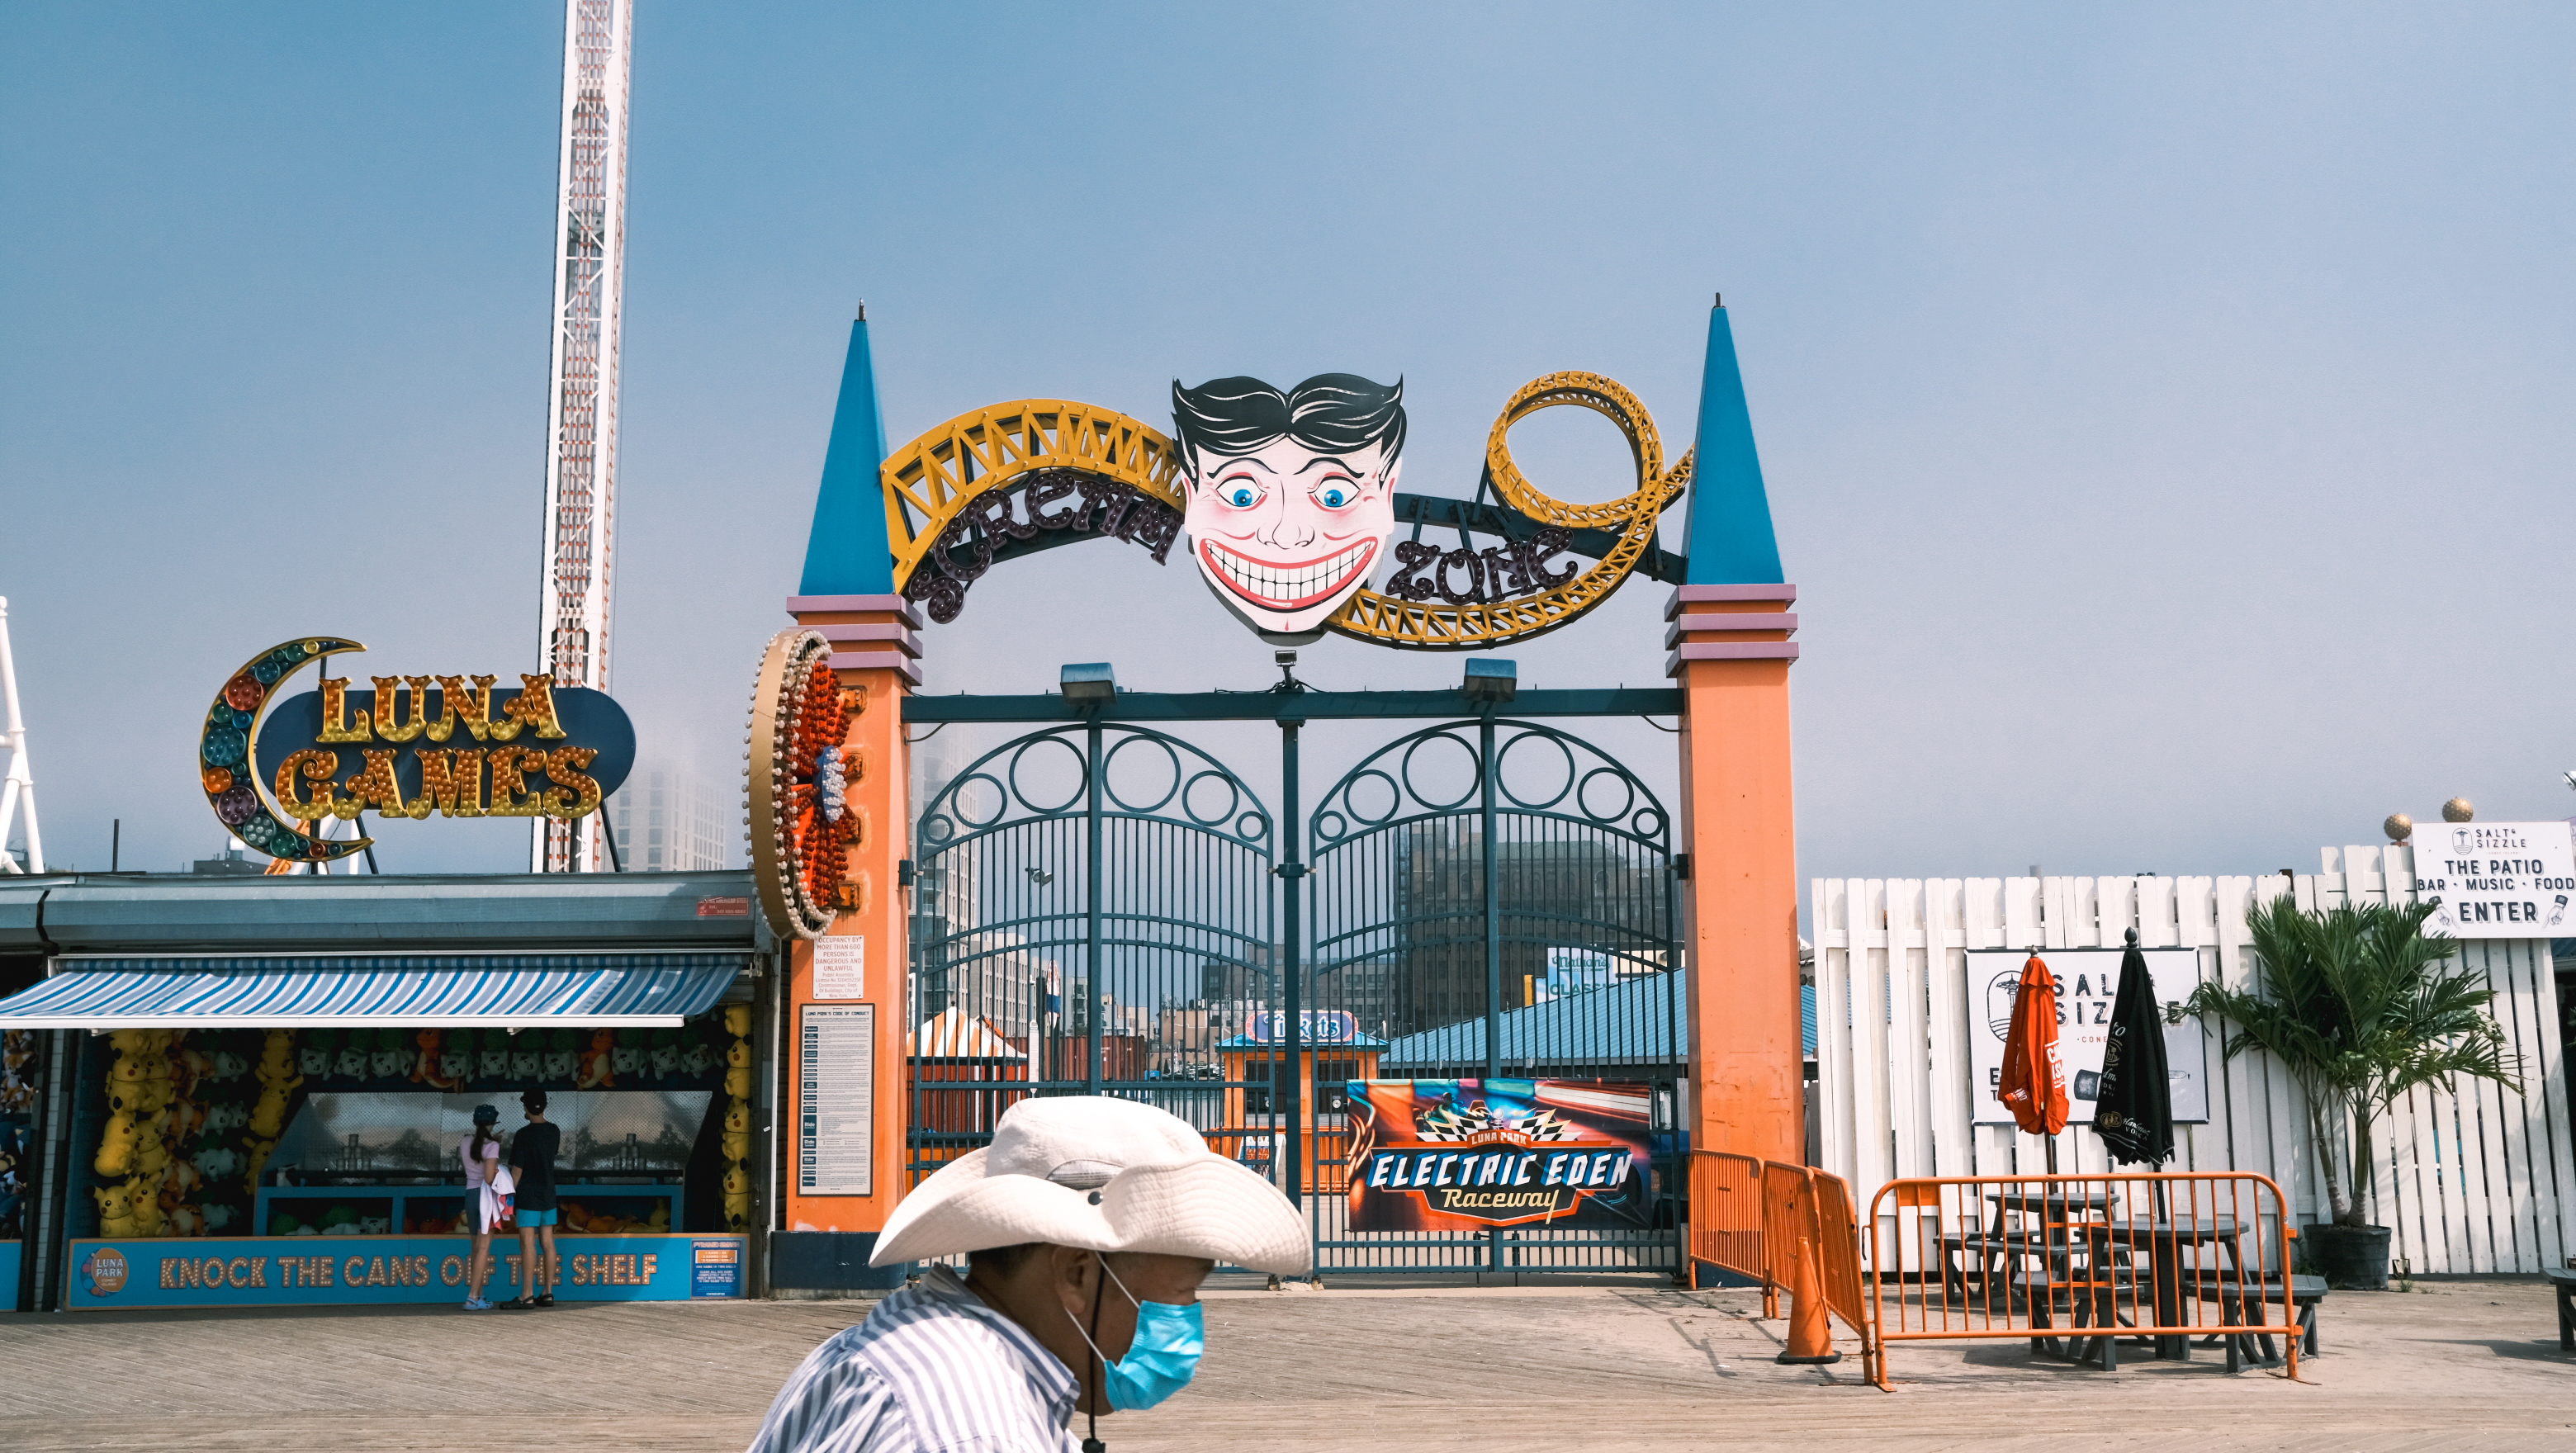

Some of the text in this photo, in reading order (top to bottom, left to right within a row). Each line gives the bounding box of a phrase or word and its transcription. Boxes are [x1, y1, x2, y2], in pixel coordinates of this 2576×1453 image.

[1385, 528, 1579, 605] ZONE
[316, 674, 566, 743] LUNA
[275, 745, 602, 820] GAMES
[2475, 828, 2509, 838] SALT
[2477, 839, 2526, 848] SIZZLE
[2445, 859, 2544, 875] THE PATIO
[2417, 878, 2575, 891] BAR MUSIC FOOD
[2459, 902, 2538, 923] ENTER
[1550, 983, 1616, 995] CLAS
[2053, 974, 2114, 997] SAL
[2055, 1001, 2181, 1025] SIZE
[1262, 1014, 1339, 1039] ikts
[1470, 1131, 1527, 1145] LUNA PARK
[2125, 1126, 2147, 1141] VOKA
[1366, 1151, 1537, 1187] ELECTRIC
[1541, 1150, 1633, 1186] EDEN
[1440, 1189, 1560, 1224] Raceway
[96, 1268, 123, 1277] PARK
[97, 1259, 123, 1267] LUNA
[159, 1257, 268, 1289] KNOCK
[277, 1255, 334, 1288] THE
[343, 1254, 431, 1287] CANS
[571, 1253, 657, 1286] SHELF
